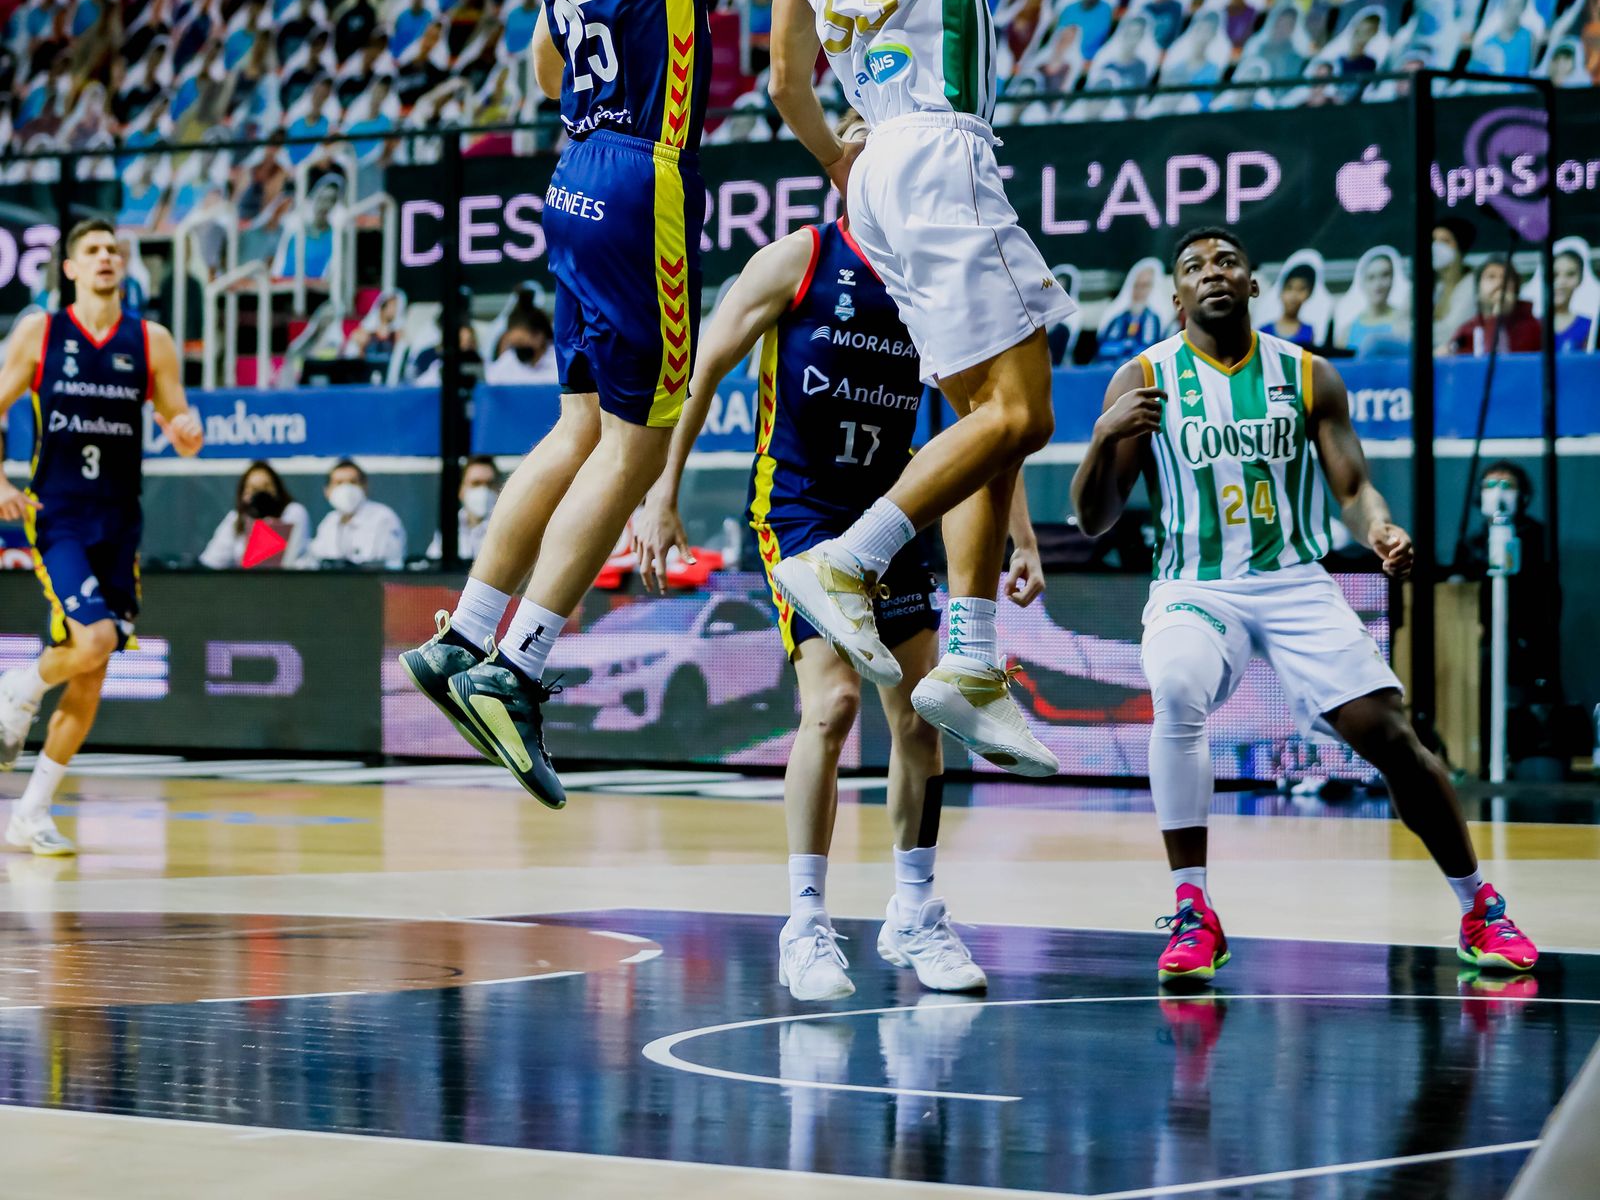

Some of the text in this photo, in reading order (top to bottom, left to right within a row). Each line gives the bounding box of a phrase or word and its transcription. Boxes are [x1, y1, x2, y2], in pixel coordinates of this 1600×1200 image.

[832, 377, 919, 411] Andorra
[190, 400, 306, 446] ndorra
[835, 420, 881, 467] 17
[81, 444, 101, 480] 3
[1222, 480, 1276, 526] 24
